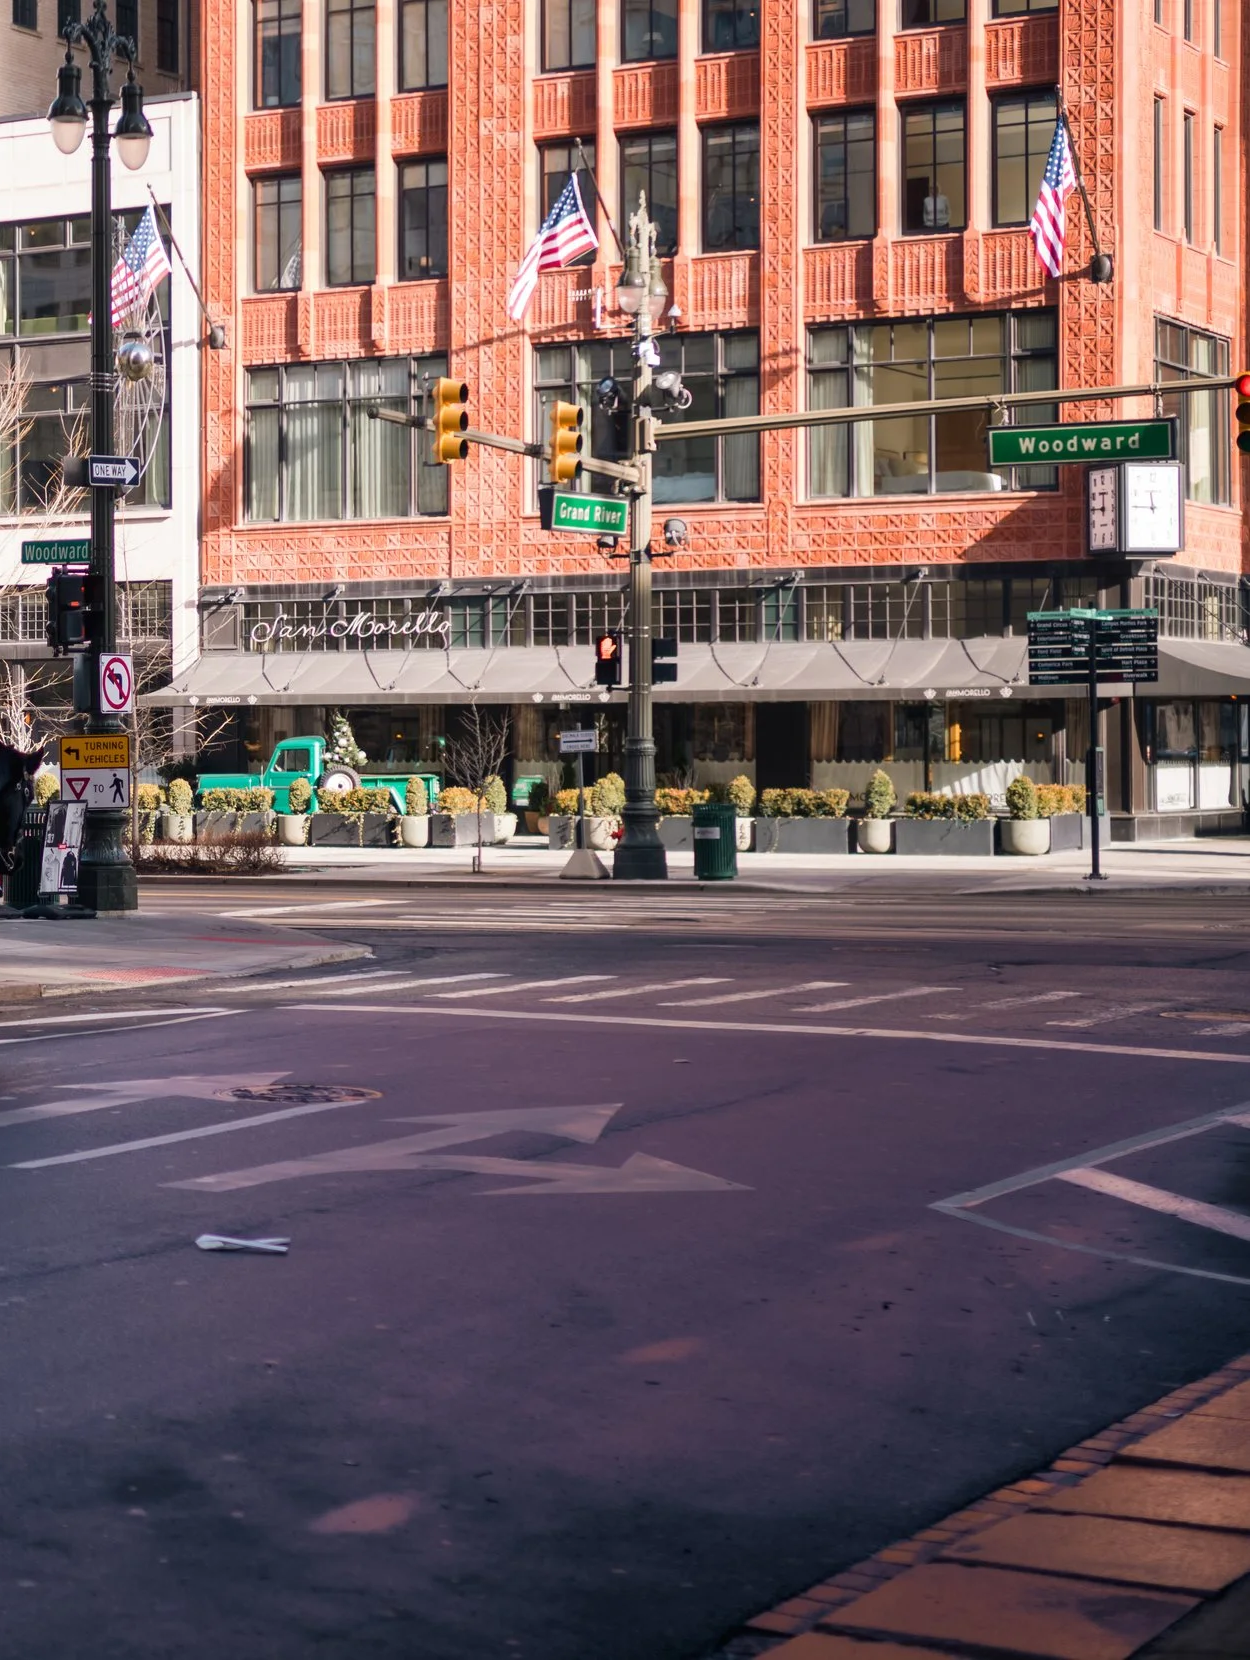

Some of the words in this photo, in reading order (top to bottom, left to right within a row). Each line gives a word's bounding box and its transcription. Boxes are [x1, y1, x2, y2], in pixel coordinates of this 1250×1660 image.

[1018, 432, 1140, 454] Woodward
[94, 464, 110, 477] ONE
[111, 465, 127, 477] WAY
[559, 502, 591, 521] Grand
[594, 505, 622, 525] River
[24, 541, 89, 561] Woodward
[251, 614, 327, 643] San
[330, 611, 452, 638] Morello
[84, 741, 124, 751] TURNING
[83, 754, 126, 764] VEHICLES
[93, 784, 105, 793] TO
